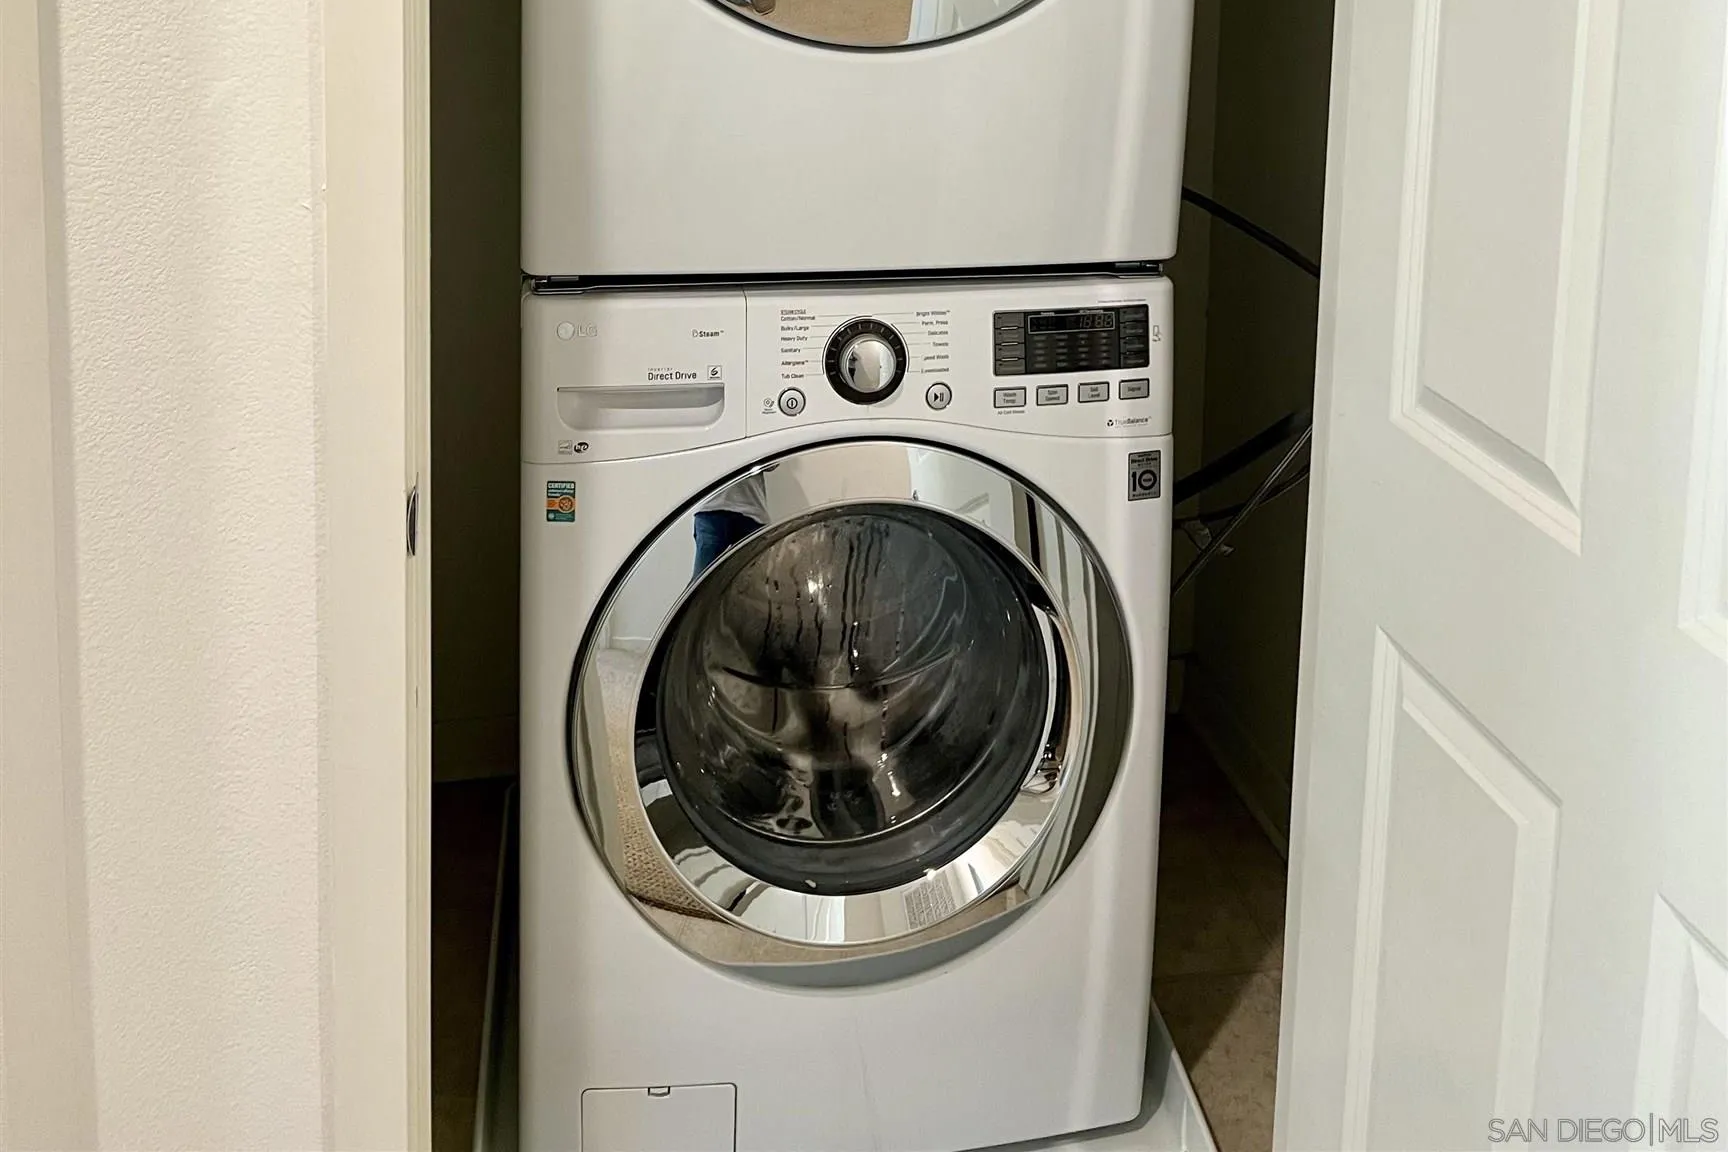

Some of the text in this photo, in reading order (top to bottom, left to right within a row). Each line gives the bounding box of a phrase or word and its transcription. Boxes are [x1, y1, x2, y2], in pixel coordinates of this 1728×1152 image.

[647, 370, 698, 381] Direct Drive
[1131, 469, 1158, 493] 10
